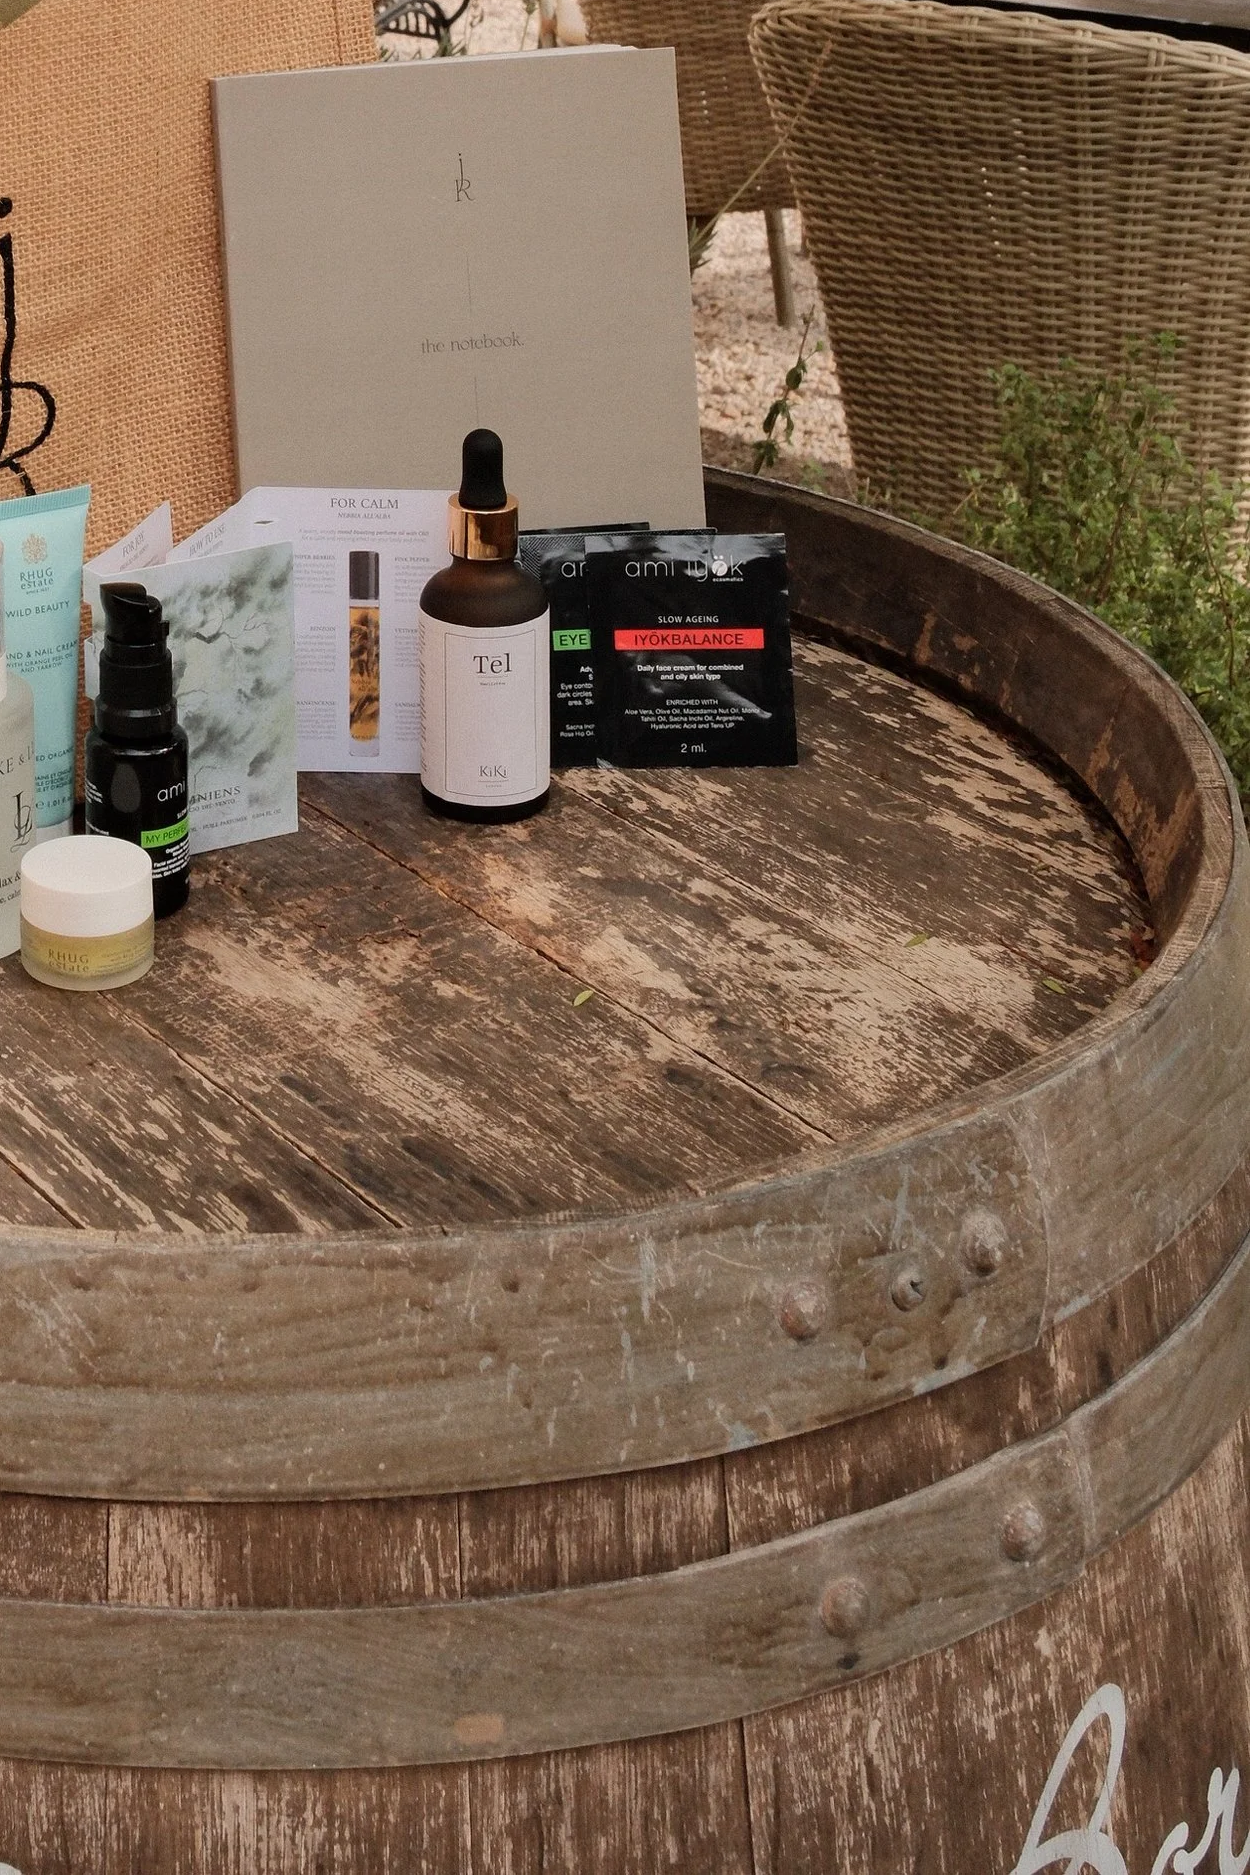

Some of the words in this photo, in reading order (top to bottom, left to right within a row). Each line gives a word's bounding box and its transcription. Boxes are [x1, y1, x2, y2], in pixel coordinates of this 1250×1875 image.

[421, 338, 445, 354] the
[450, 331, 525, 352] notebook.
[330, 497, 356, 509] FOR
[360, 498, 399, 509] CALM
[625, 557, 675, 578] ami
[19, 567, 53, 582] RHUG
[20, 577, 54, 590] estate
[5, 607, 32, 619] WILD
[35, 600, 70, 614] BEAUTY
[657, 615, 683, 624] SLOW
[685, 615, 719, 624] AGEING
[559, 633, 588, 647] EYE
[634, 633, 744, 647] IYÖKBALANCE
[34, 648, 54, 657] NAIL
[637, 664, 654, 672] Daily
[656, 664, 672, 672] face
[708, 663, 744, 671] combined
[660, 673, 674, 681] and
[675, 673, 688, 681] oily
[705, 673, 721, 681] type
[680, 743, 687, 753] 2
[691, 743, 707, 753] ml.
[157, 776, 186, 802] ami
[145, 834, 159, 844] MY
[48, 948, 89, 964] RHUG
